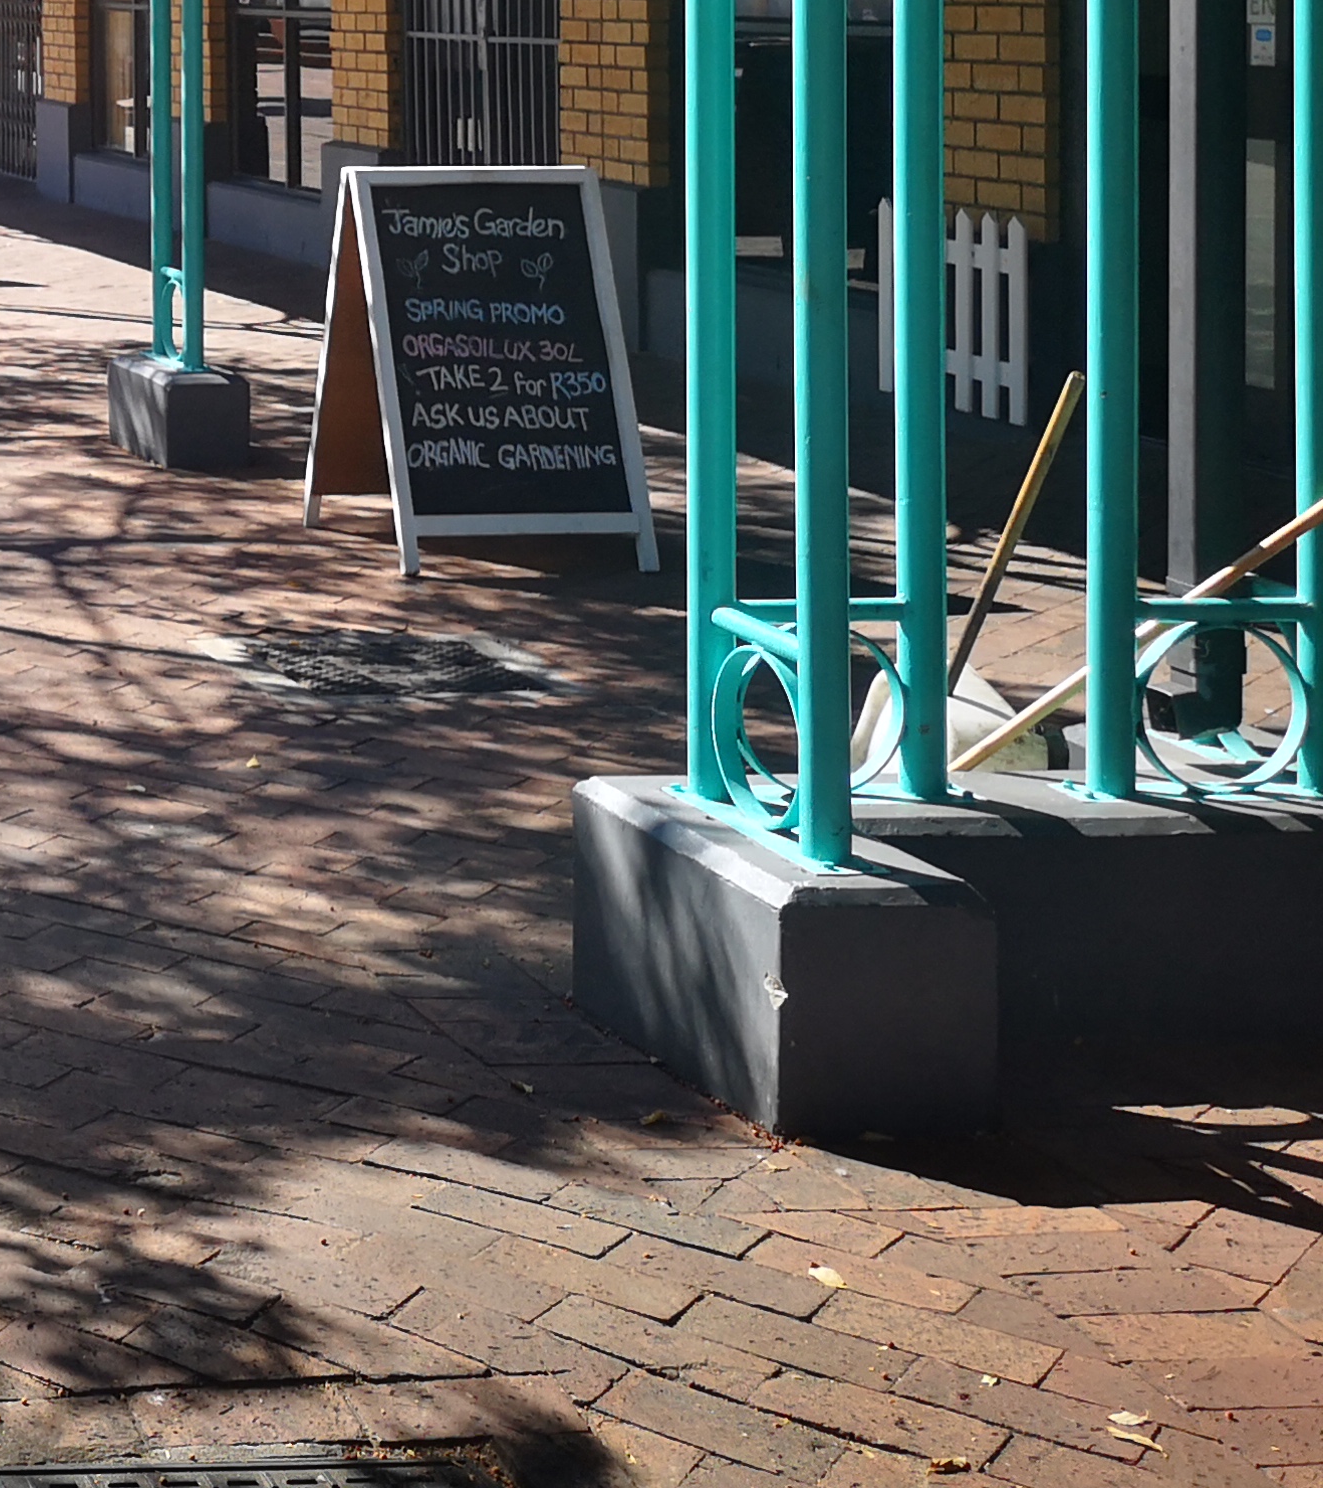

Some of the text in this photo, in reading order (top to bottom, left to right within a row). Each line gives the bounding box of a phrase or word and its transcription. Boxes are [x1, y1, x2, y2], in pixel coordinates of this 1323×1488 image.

[382, 206, 565, 239] Jamie's Garden
[441, 243, 503, 278] Shop
[405, 297, 565, 326] SPRING PROMO
[539, 340, 583, 362] 30L
[415, 364, 486, 391] TAKE
[488, 367, 509, 392] 2
[550, 370, 606, 400] R350
[412, 402, 465, 430] ASK
[503, 404, 589, 432] ABOUT
[407, 437, 617, 471] ORGANIC GARDENING
